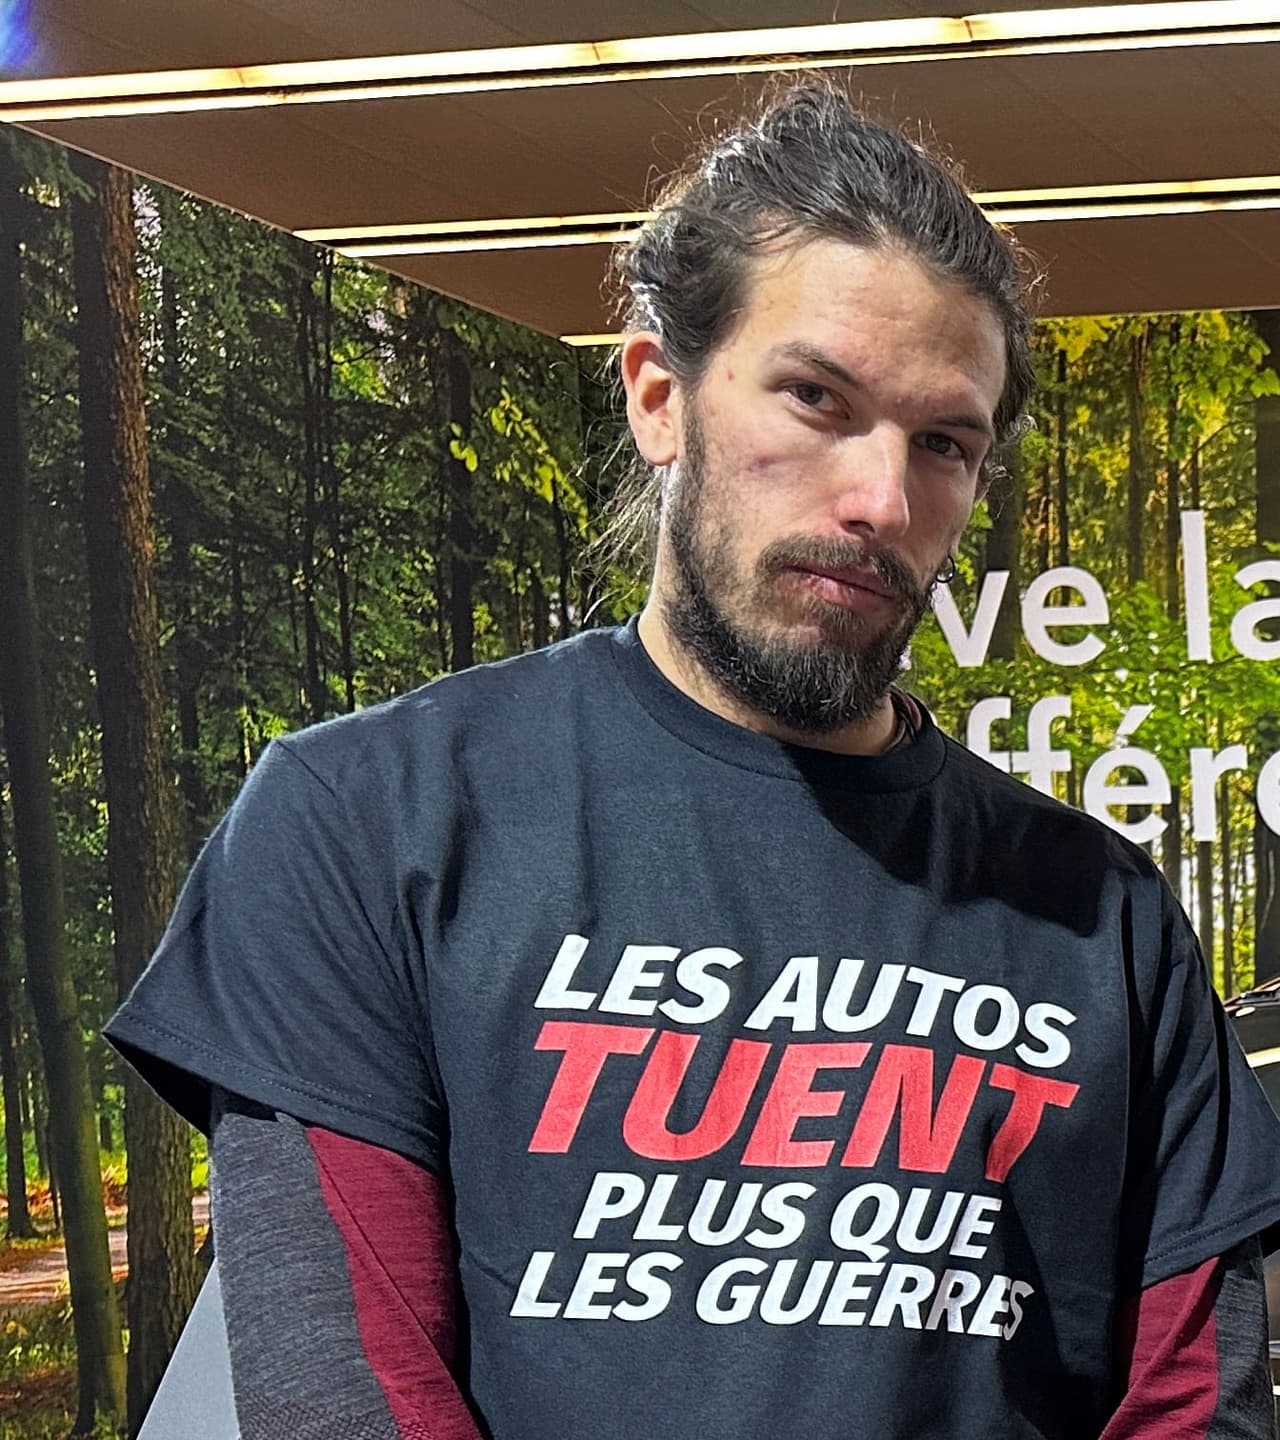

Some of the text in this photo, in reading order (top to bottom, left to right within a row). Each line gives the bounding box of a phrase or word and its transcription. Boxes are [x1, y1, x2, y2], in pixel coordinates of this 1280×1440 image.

[928, 566, 1110, 669] ve
[533, 933, 1078, 1069] LES AUTOS
[527, 1020, 1080, 1183] TUENT
[573, 1172, 1003, 1262] PLUS QUE
[509, 1251, 1036, 1341] LES GUERRES
